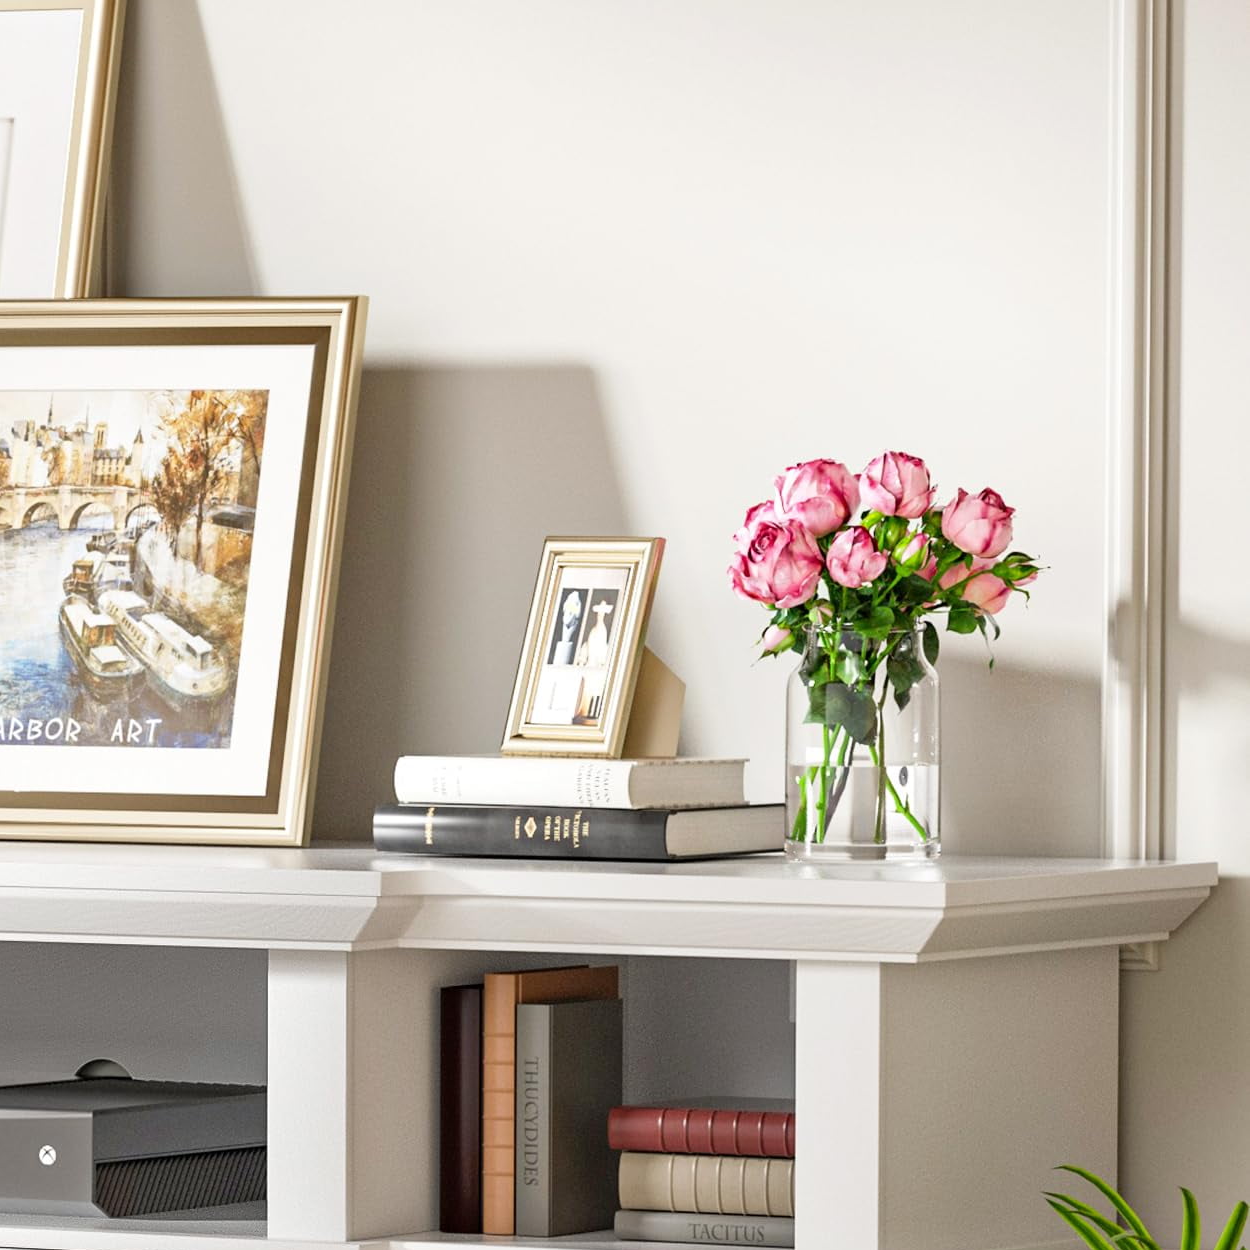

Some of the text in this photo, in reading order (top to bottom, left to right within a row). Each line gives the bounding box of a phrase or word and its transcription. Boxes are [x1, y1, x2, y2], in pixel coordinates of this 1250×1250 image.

[110, 718, 162, 743] ART
[523, 1056, 540, 1187] THUCYDIDES
[687, 1222, 766, 1244] TACITUS
